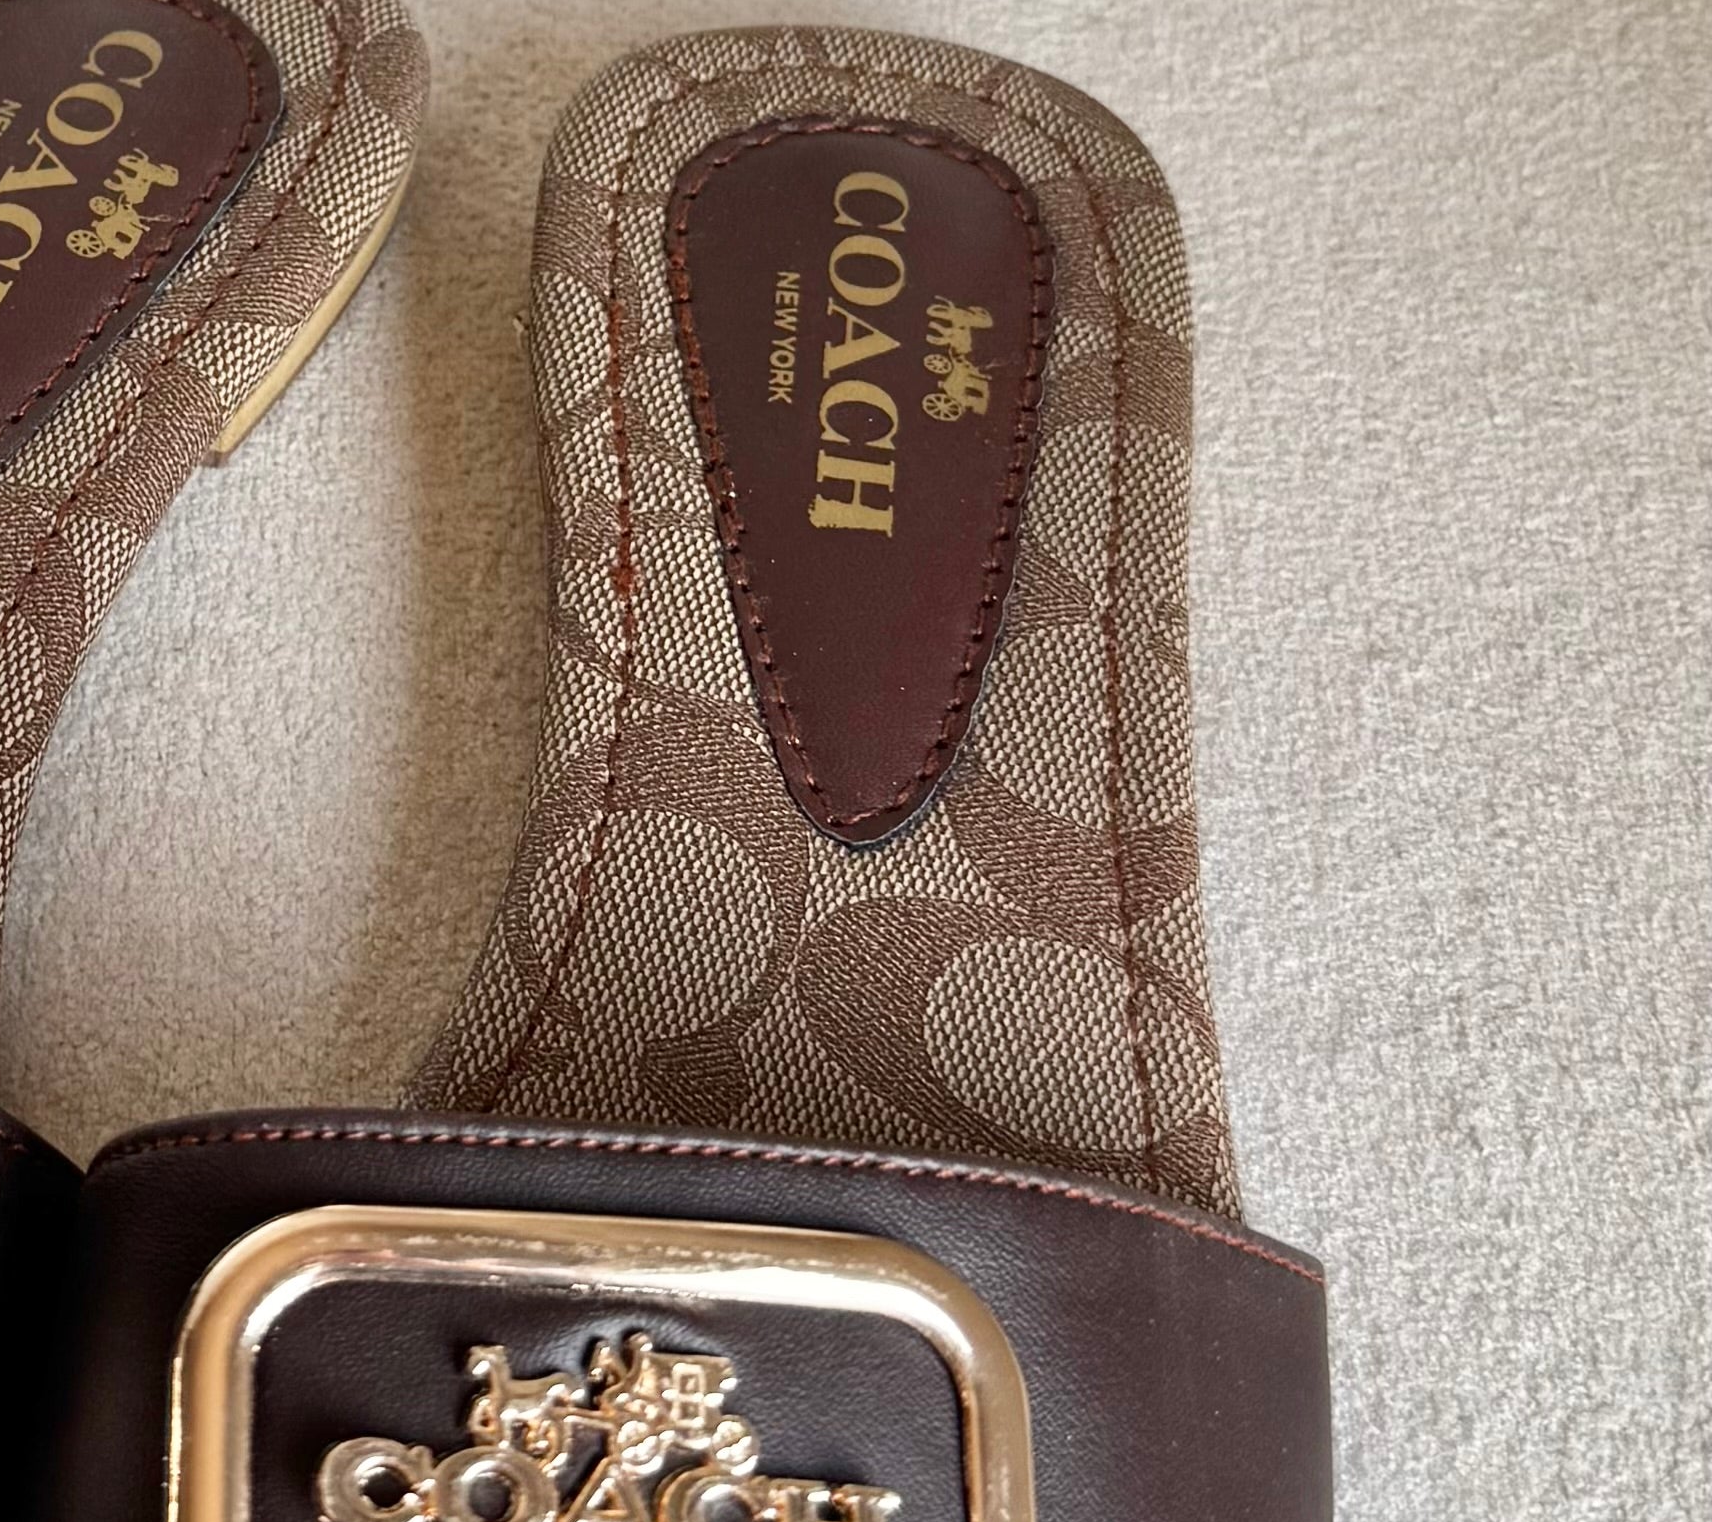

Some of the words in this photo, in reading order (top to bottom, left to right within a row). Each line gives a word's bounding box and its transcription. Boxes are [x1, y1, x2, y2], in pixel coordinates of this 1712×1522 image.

[774, 271, 801, 332] NEW
[767, 336, 797, 404] YORK
[808, 171, 910, 538] COACH
